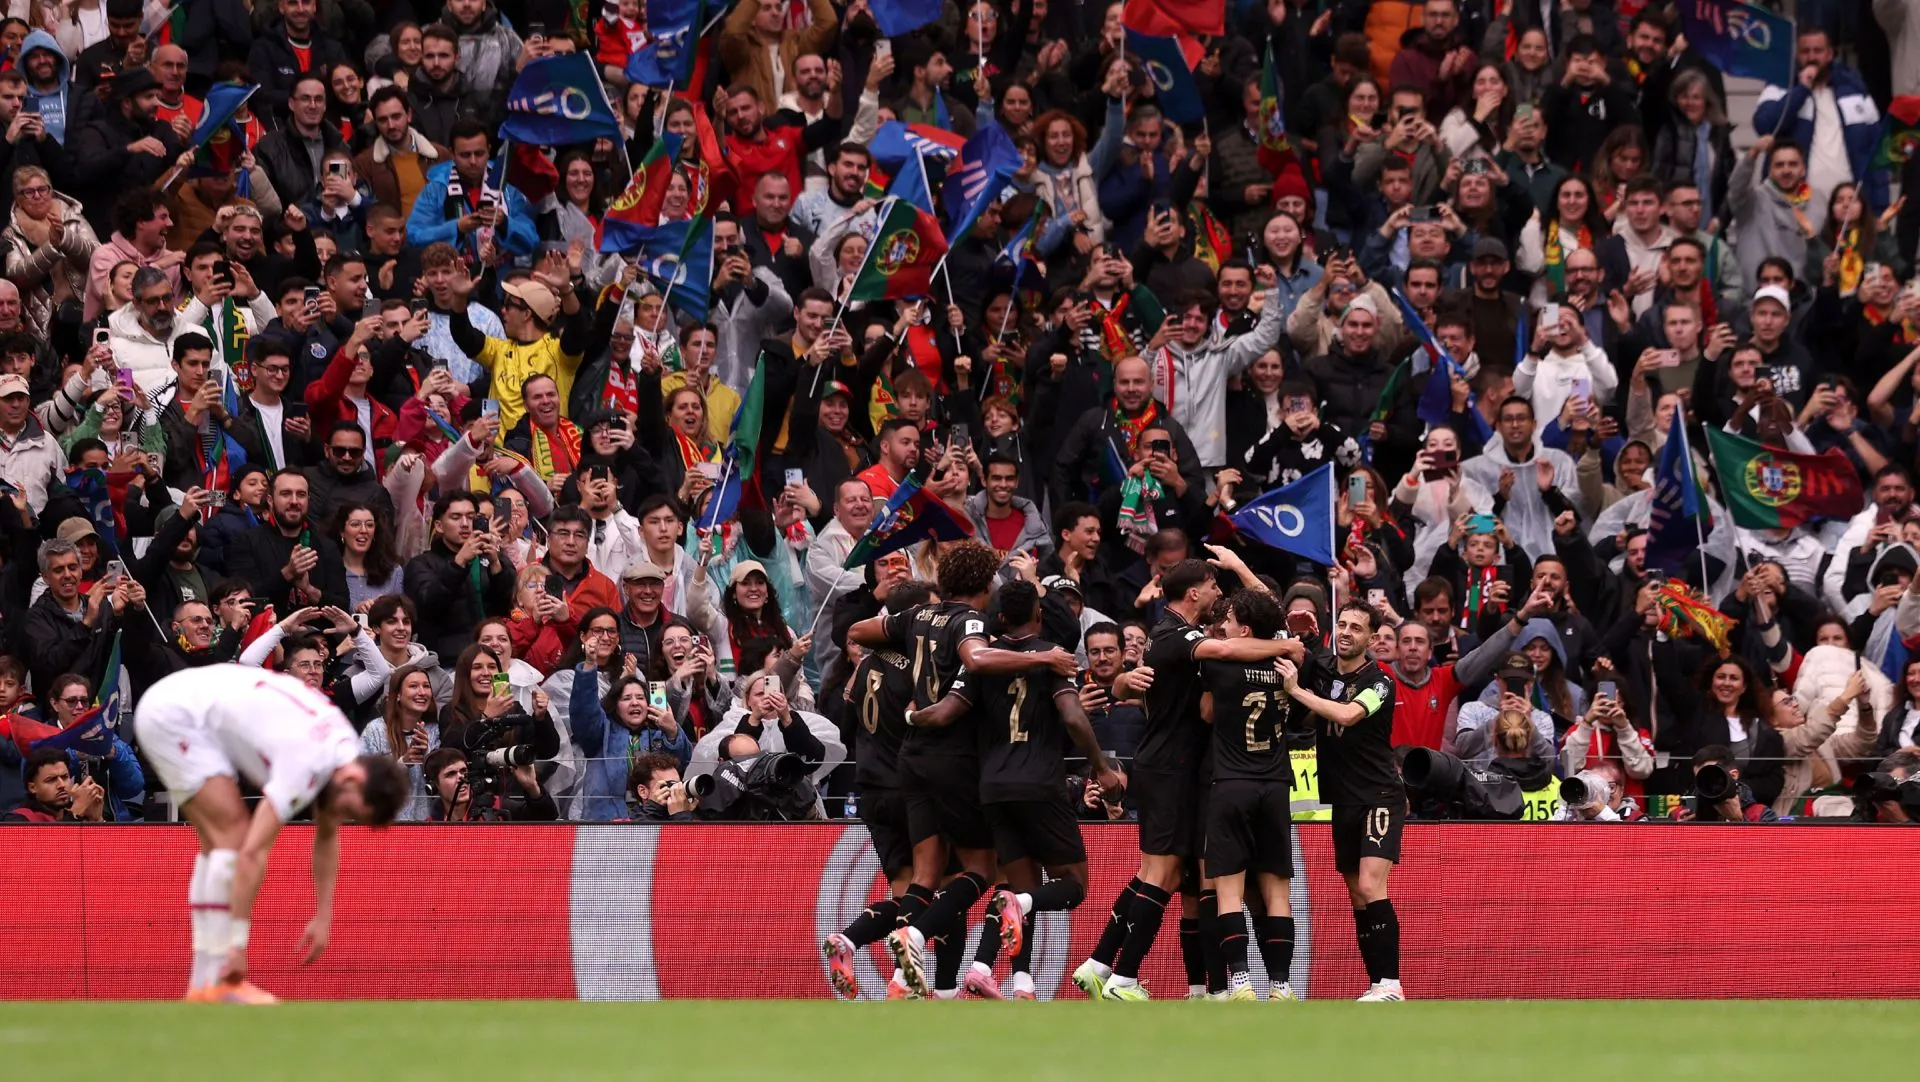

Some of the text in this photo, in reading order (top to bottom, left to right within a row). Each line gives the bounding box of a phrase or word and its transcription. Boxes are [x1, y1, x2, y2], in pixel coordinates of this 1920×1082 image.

[1053, 578, 1077, 588] BOSS
[864, 669, 884, 734] 8
[1007, 677, 1029, 744] 2
[1366, 807, 1390, 836] 10
